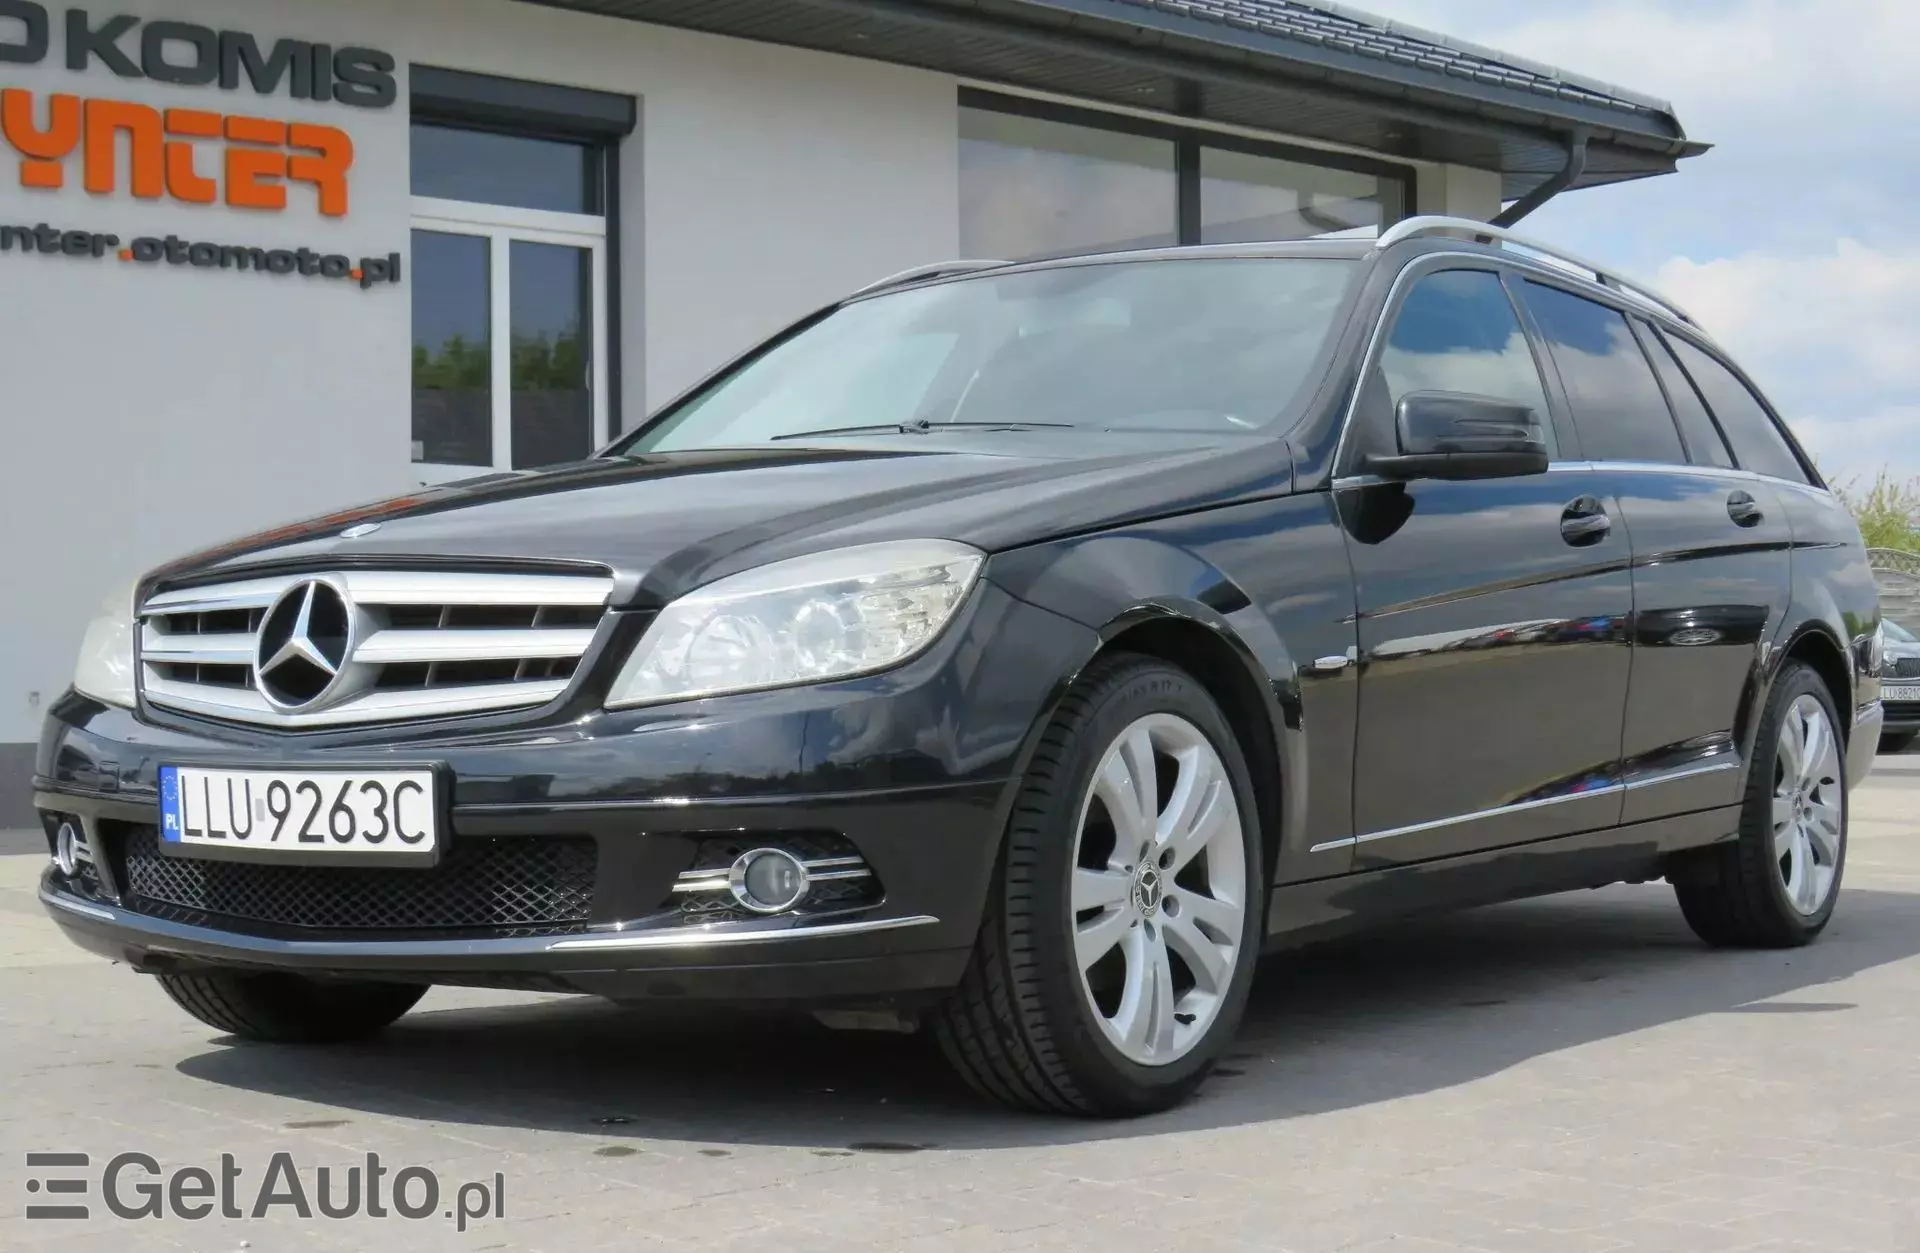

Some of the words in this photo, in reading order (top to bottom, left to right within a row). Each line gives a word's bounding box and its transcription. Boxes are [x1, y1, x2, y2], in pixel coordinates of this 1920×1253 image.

[66, 9, 397, 108] KOMIS
[0, 222, 401, 289] nter.otomoto.pl
[165, 813, 180, 831] PL
